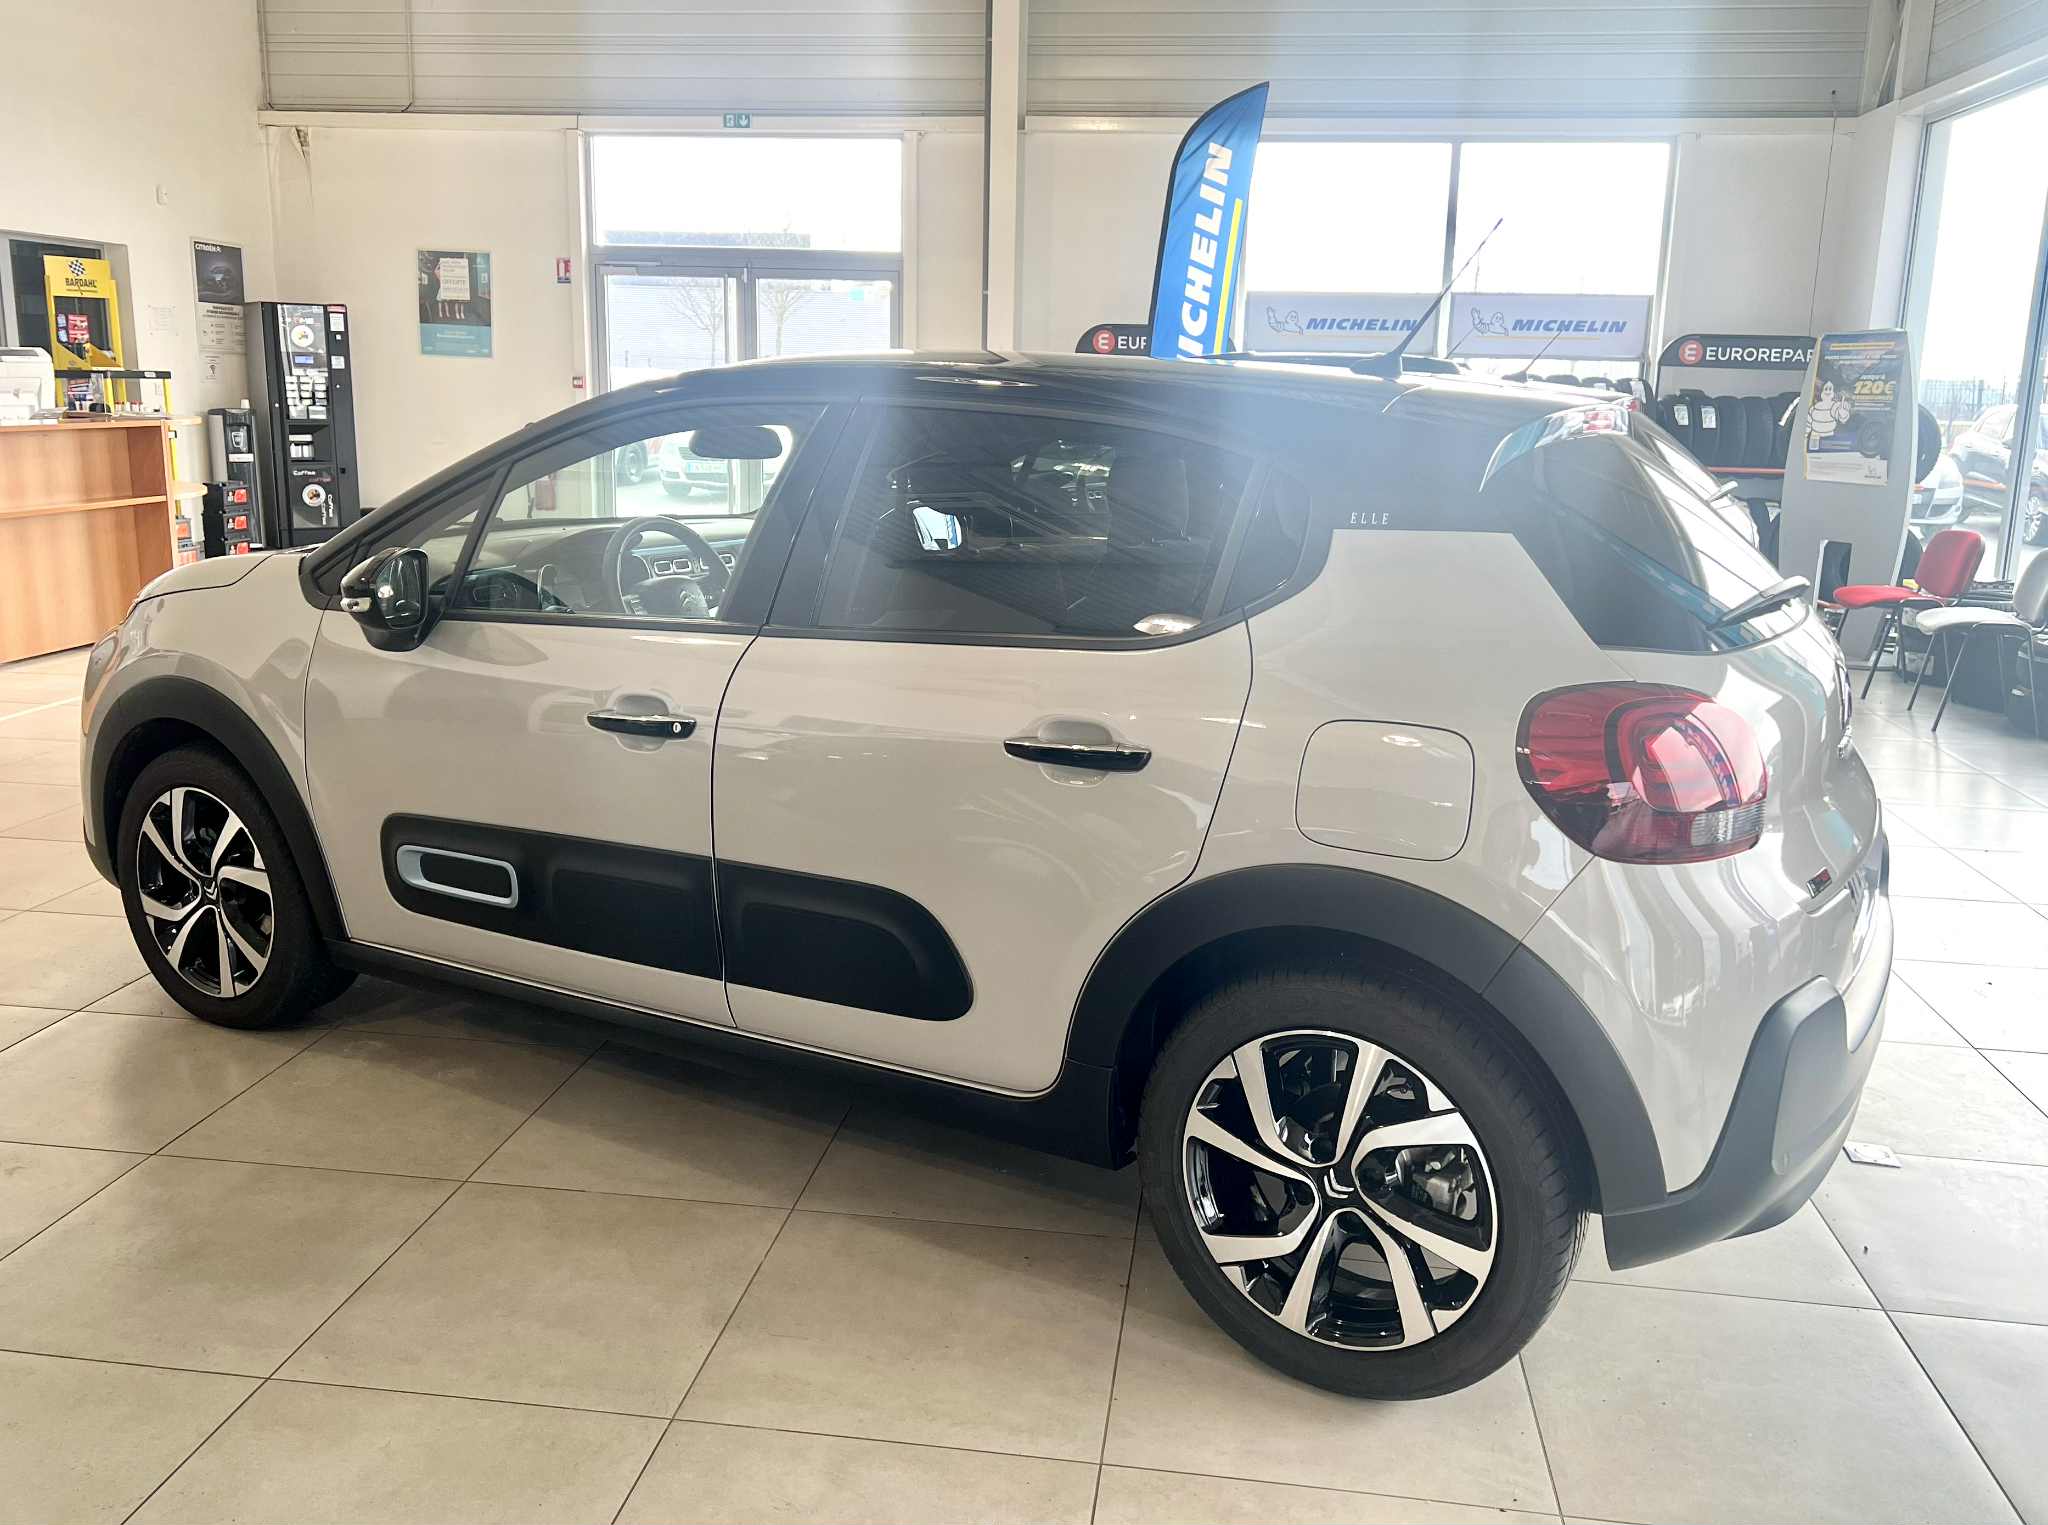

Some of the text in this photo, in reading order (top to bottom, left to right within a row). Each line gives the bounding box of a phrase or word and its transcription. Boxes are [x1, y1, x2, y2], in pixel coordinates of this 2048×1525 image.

[1177, 142, 1233, 361] ICHELIN
[65, 277, 97, 289] BARDAHL
[1305, 318, 1418, 332] MICHELIN
[1511, 318, 1628, 333] MICHELIN
[1854, 380, 1897, 395] 120€
[1350, 511, 1390, 525] ELLE
